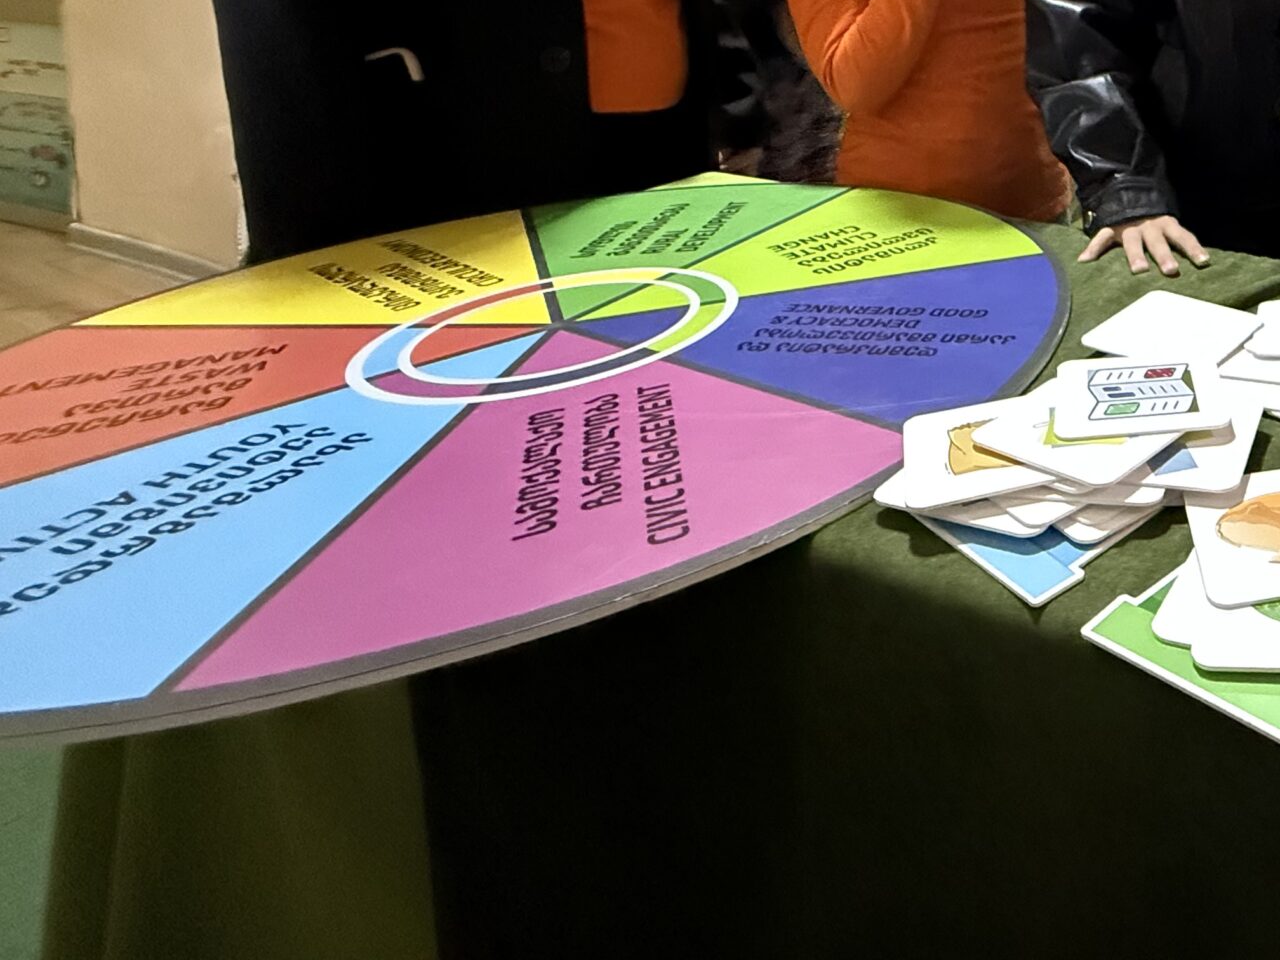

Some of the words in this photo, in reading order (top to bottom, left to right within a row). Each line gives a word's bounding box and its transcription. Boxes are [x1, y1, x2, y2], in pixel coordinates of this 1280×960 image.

[640, 228, 689, 255] RURAL
[675, 202, 748, 253] DEVELOPMENT
[766, 225, 861, 252] CHANGE
[380, 239, 449, 267] ECONOMY
[782, 231, 878, 260] CLIMATE
[797, 227, 934, 268] ცვლილება
[812, 236, 939, 275] კლიმატის
[431, 257, 504, 287] CIRCULAR
[769, 315, 784, 326] &
[782, 303, 927, 317] GOVERNANCE
[787, 316, 921, 329] DEMOCRACY
[929, 307, 990, 319] GOOD
[736, 341, 770, 352] და
[754, 327, 937, 343] მმართველობა
[776, 341, 939, 358] დემოკრატია
[940, 333, 1016, 345] კარგი
[121, 360, 268, 393] WASTE
[63, 377, 253, 418] მართვა
[637, 383, 683, 491] ENGAGEMENT
[143, 422, 308, 489] YOUTH
[580, 393, 622, 511] ჩართულობა
[512, 408, 565, 541] სამოქალაქო
[50, 426, 336, 556] აქტივიზმი
[644, 488, 690, 545] CIVIC
